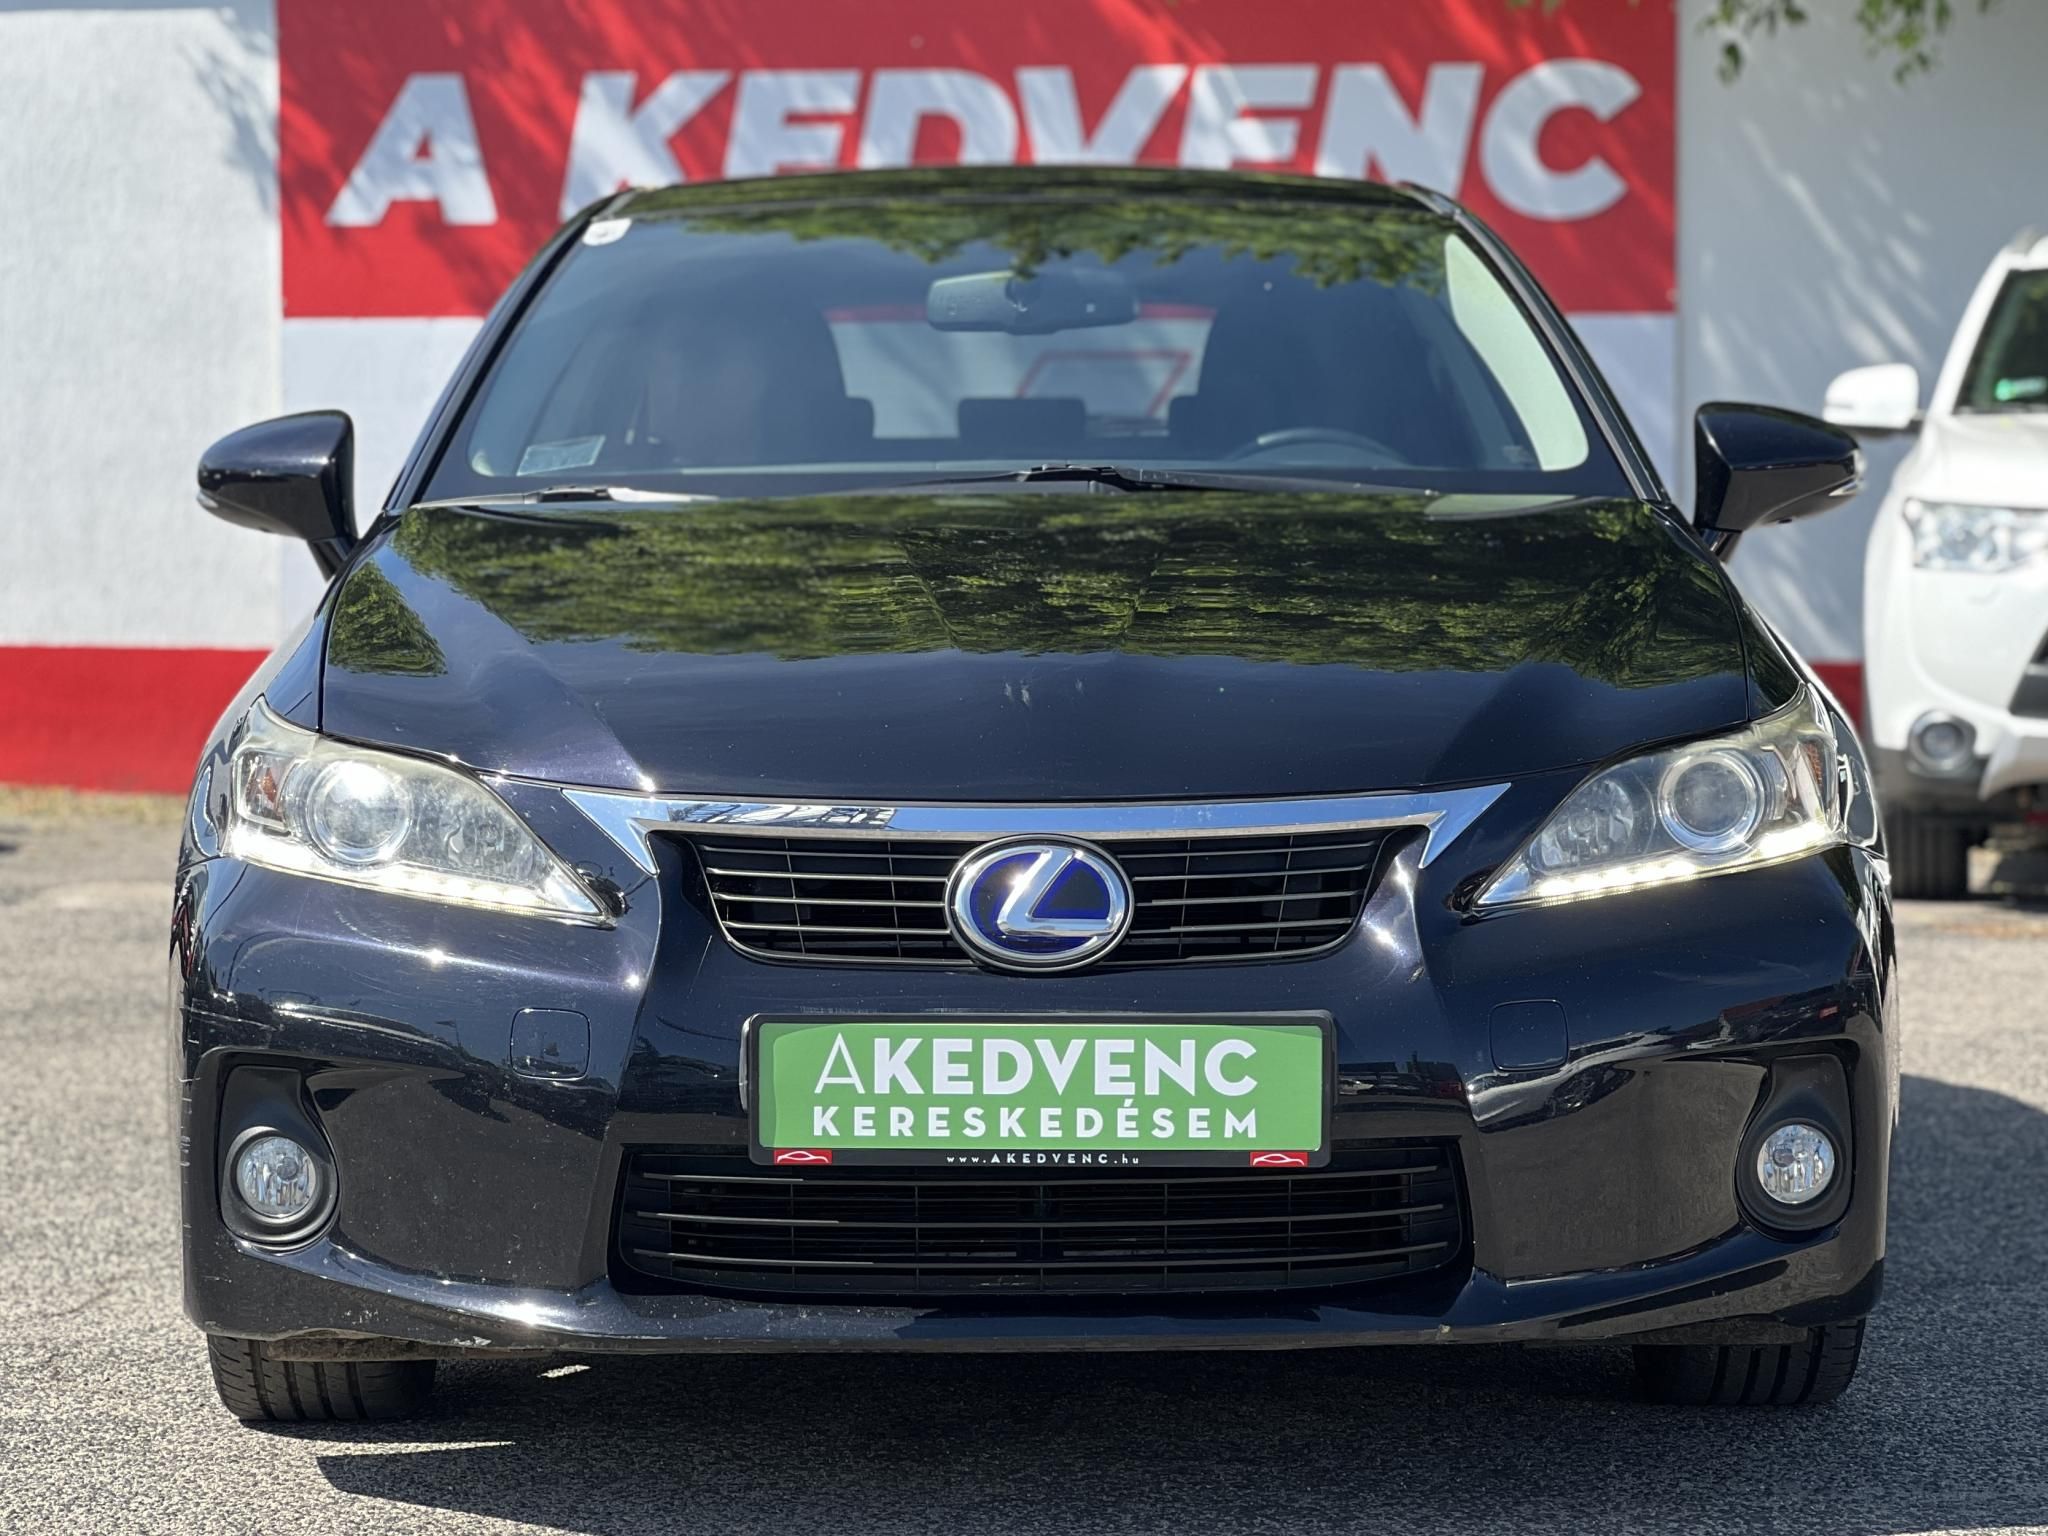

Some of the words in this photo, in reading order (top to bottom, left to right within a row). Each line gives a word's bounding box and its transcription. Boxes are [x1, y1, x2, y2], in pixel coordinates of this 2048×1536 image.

[325, 72, 498, 226] A
[559, 58, 1641, 221] KEDVENC
[813, 1098, 1257, 1139] KERESKEDÉSEM
[947, 1153, 1140, 1165] www.AKEDVENC.hu
